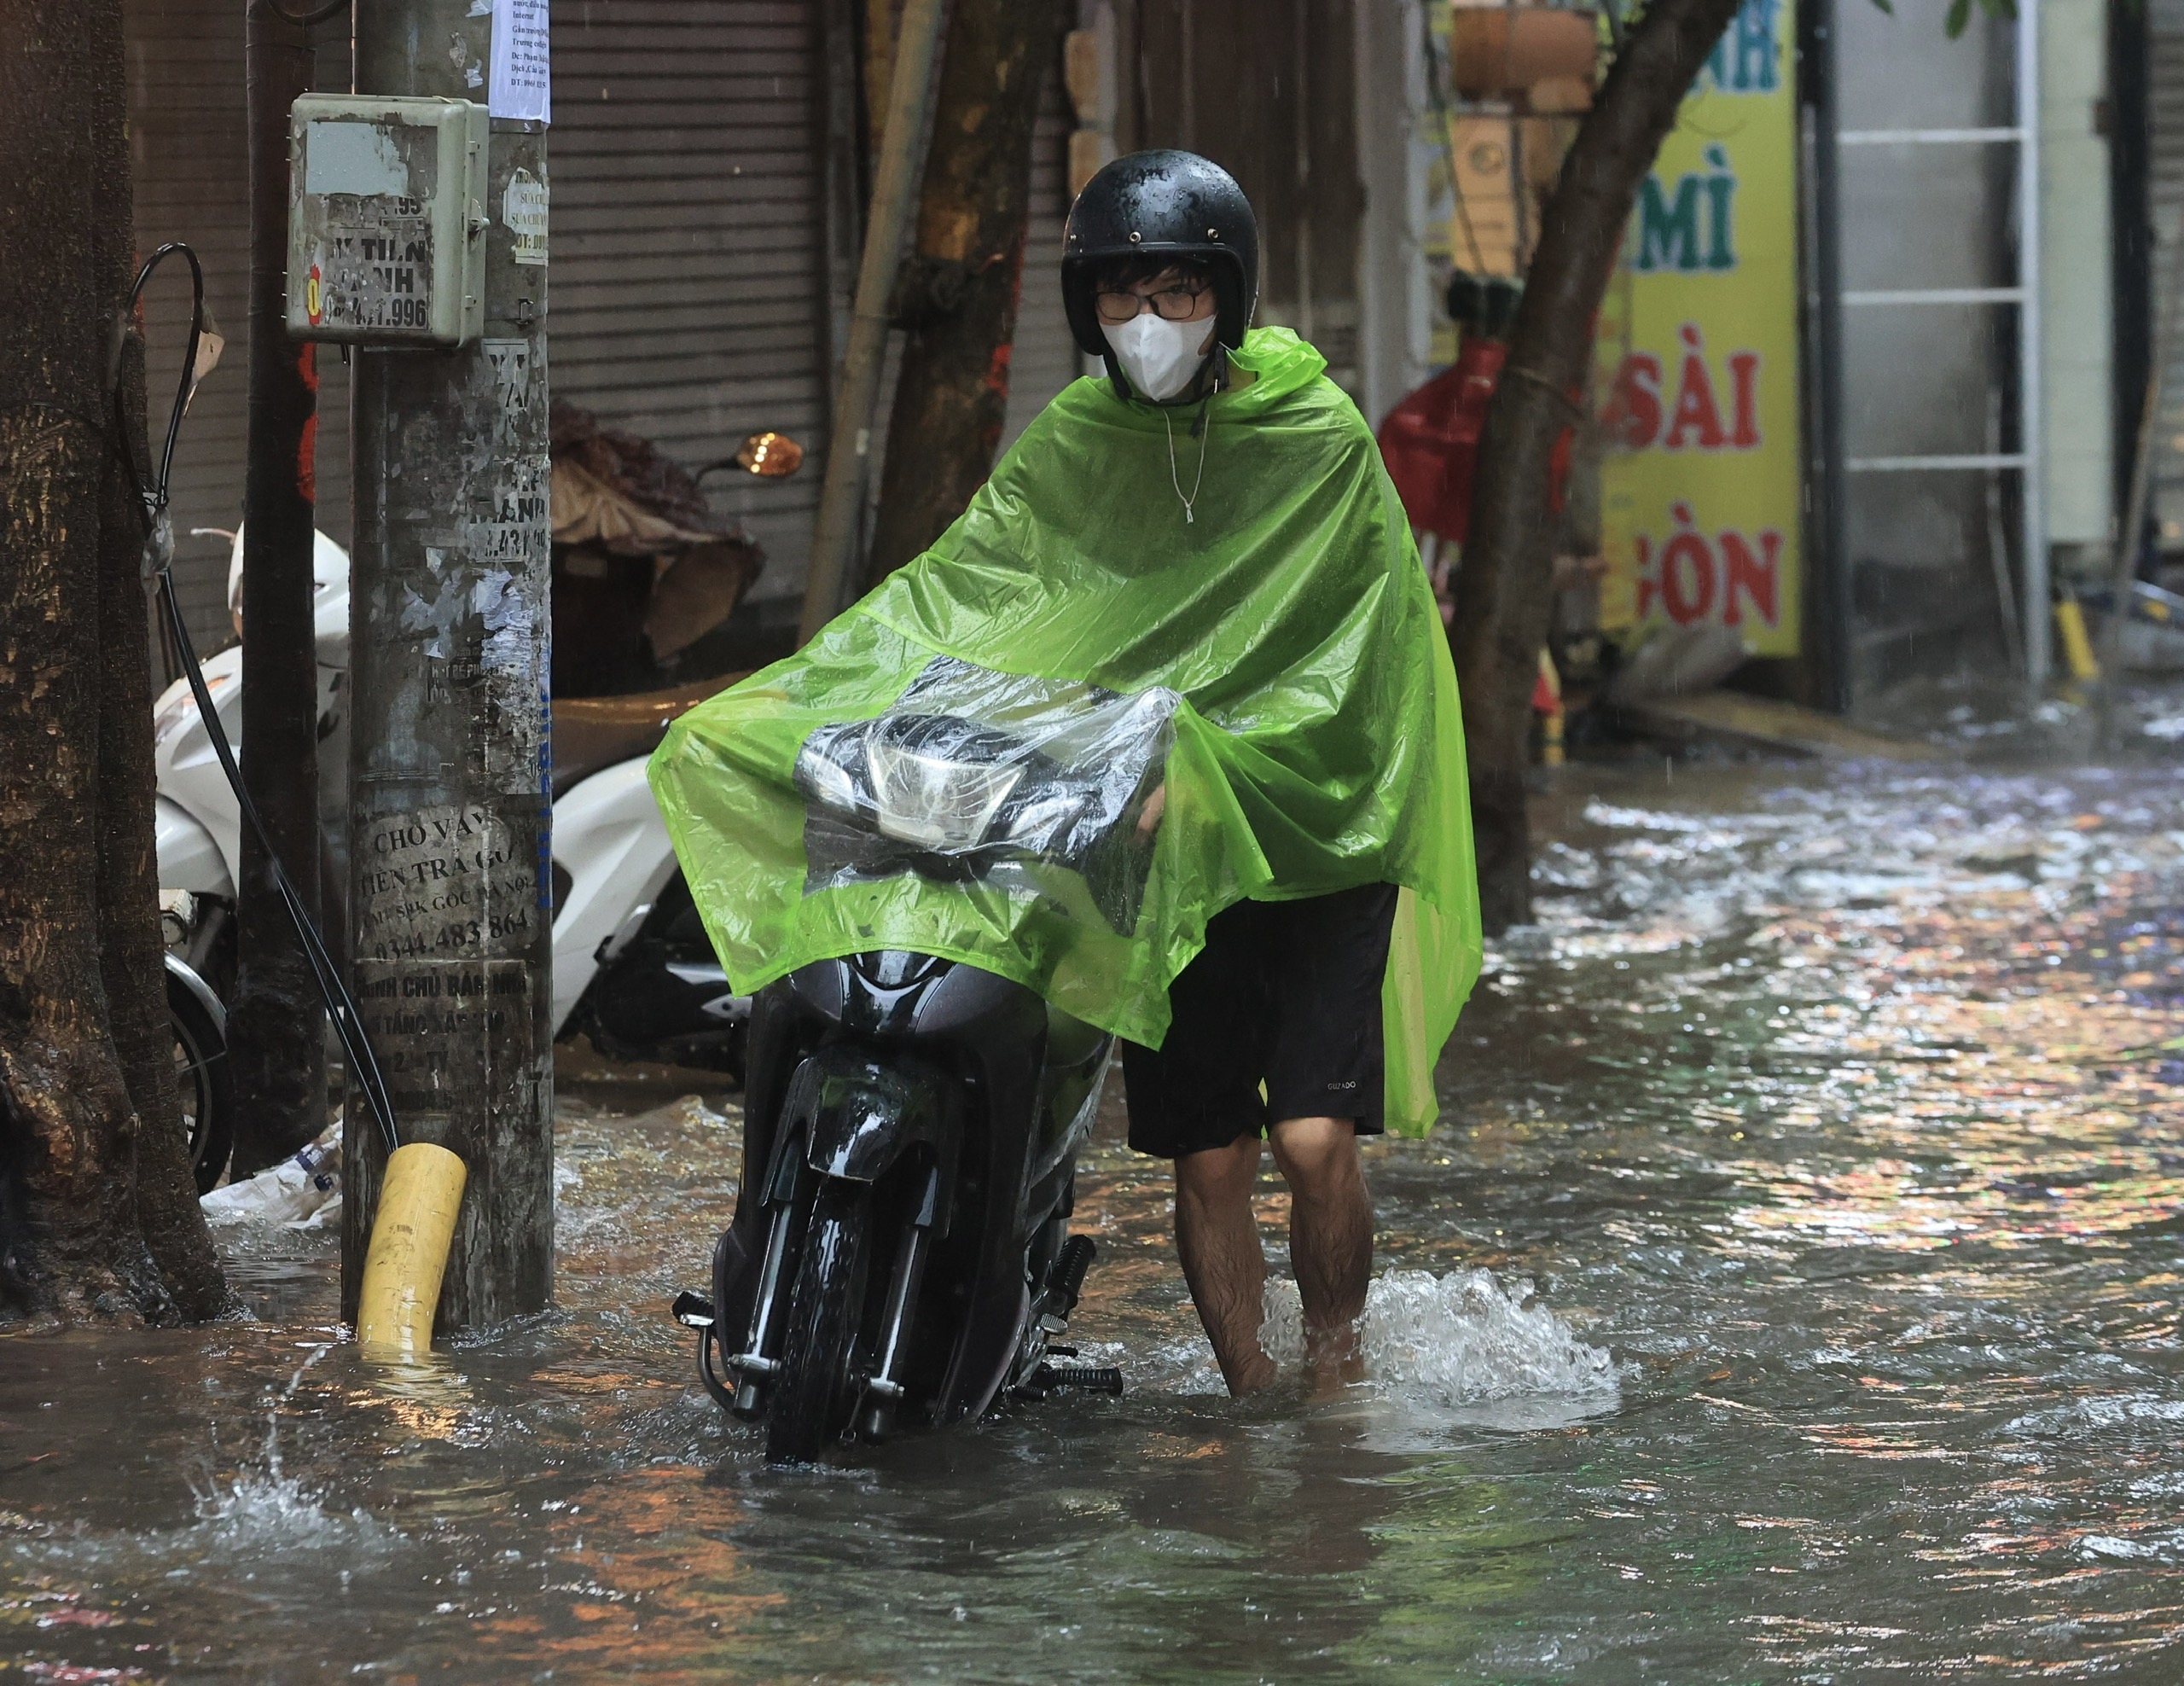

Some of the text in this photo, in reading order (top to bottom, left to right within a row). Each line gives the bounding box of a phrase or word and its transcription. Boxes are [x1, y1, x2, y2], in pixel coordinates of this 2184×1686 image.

[1633, 146, 1737, 270] MÌ
[1601, 325, 1759, 448] SÀI
[375, 823, 427, 854] CHO
